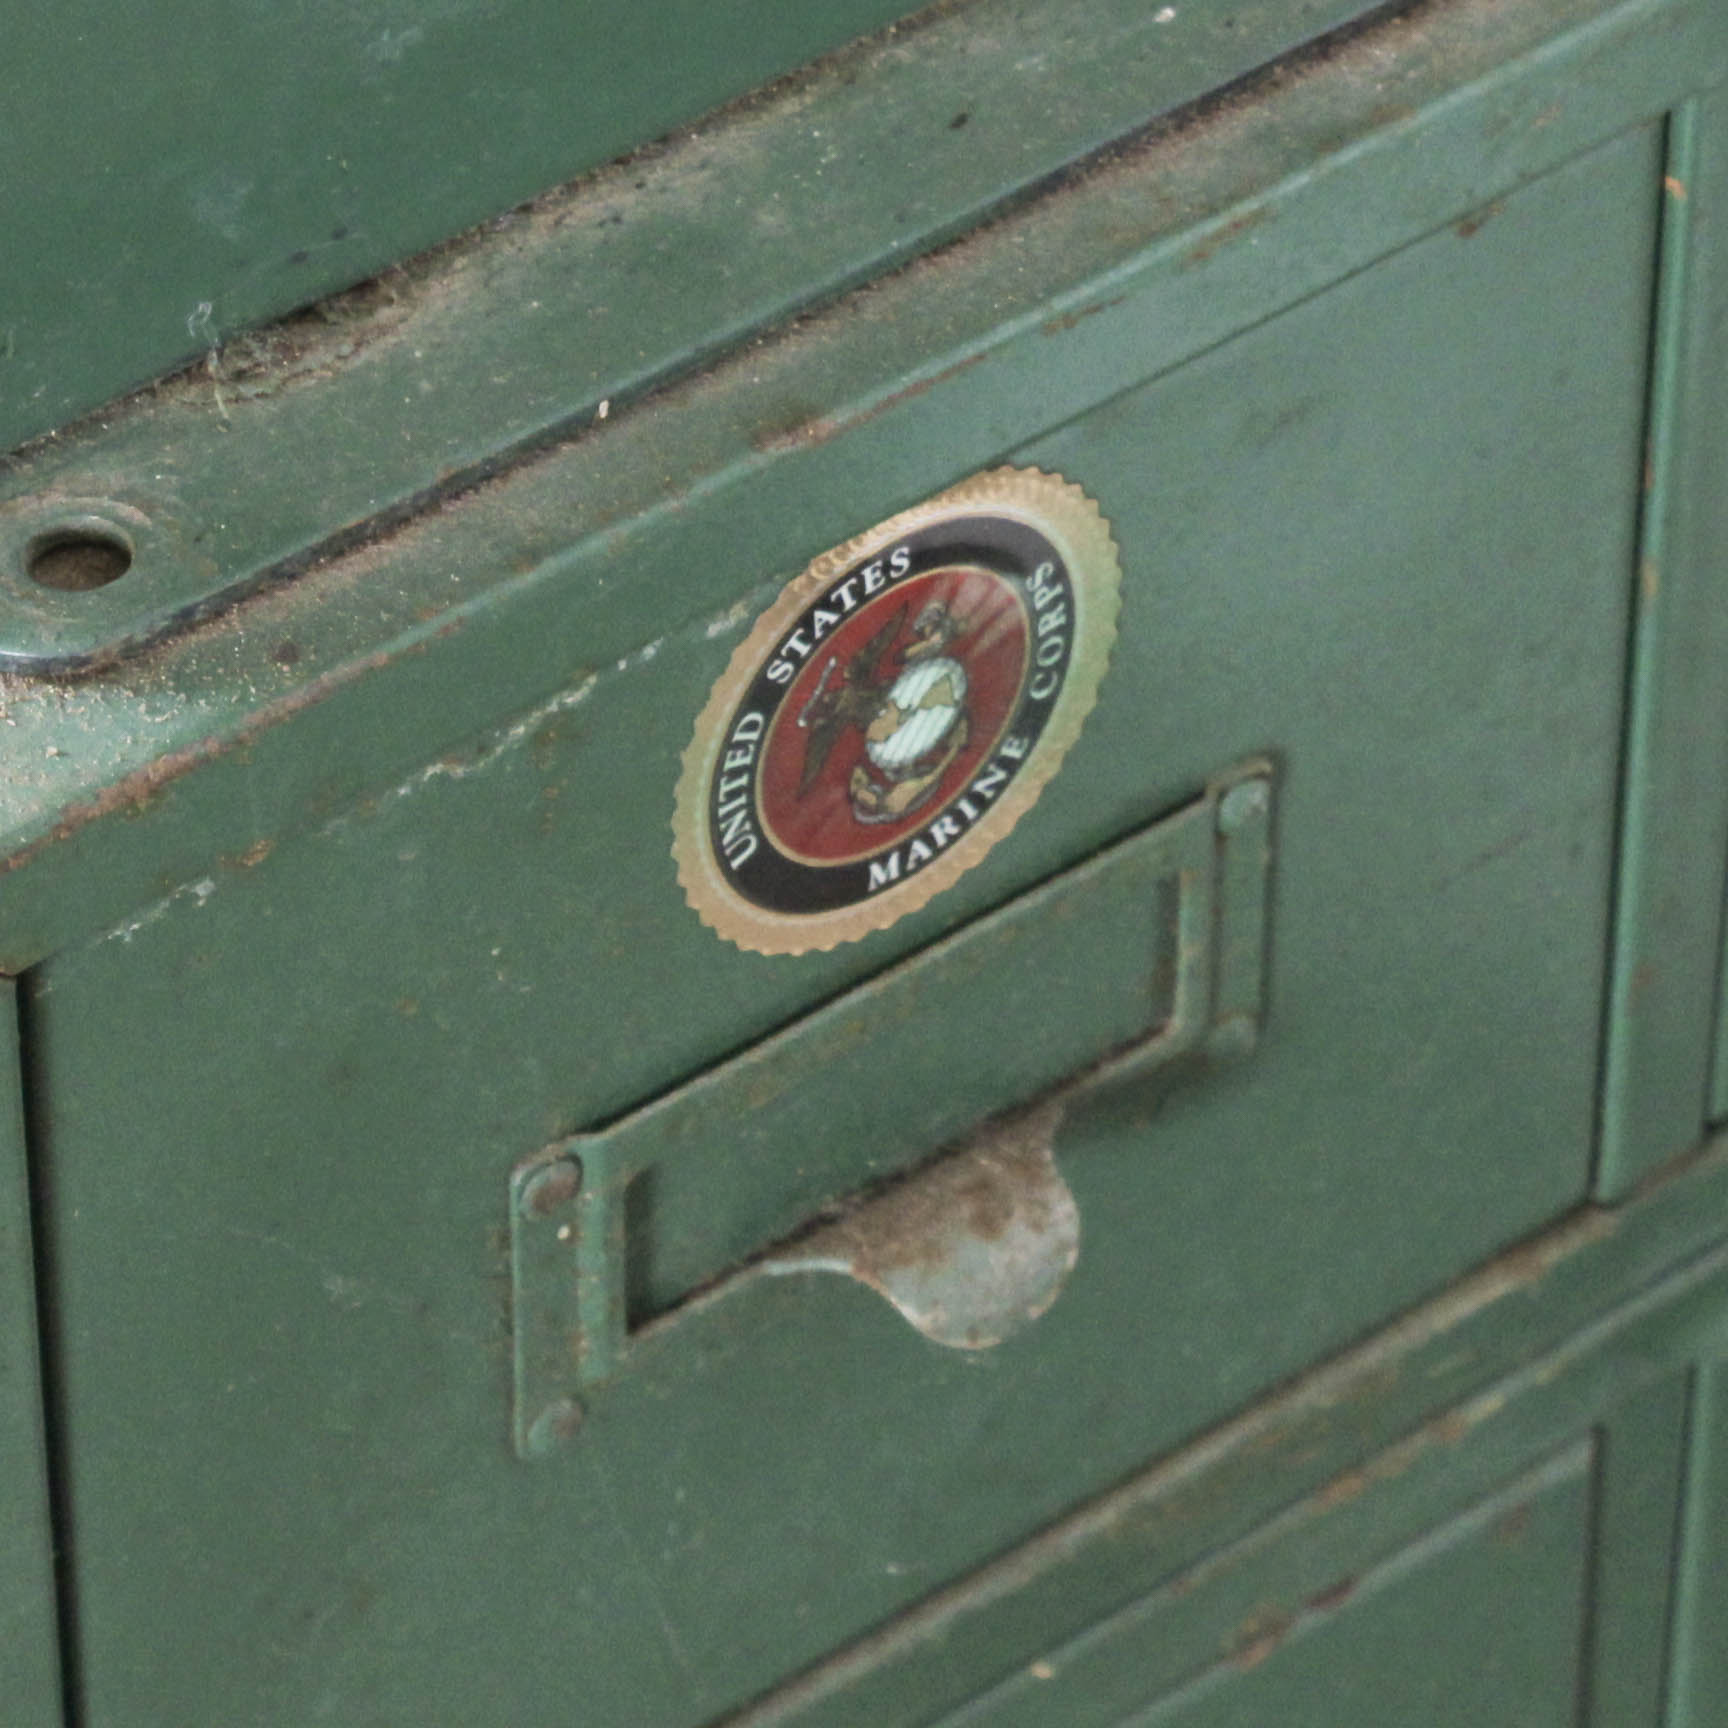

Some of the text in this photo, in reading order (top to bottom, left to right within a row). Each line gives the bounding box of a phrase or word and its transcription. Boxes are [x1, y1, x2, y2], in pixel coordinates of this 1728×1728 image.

[718, 545, 912, 871] UNITED STATES
[867, 559, 1069, 893] MARINE CORPS
